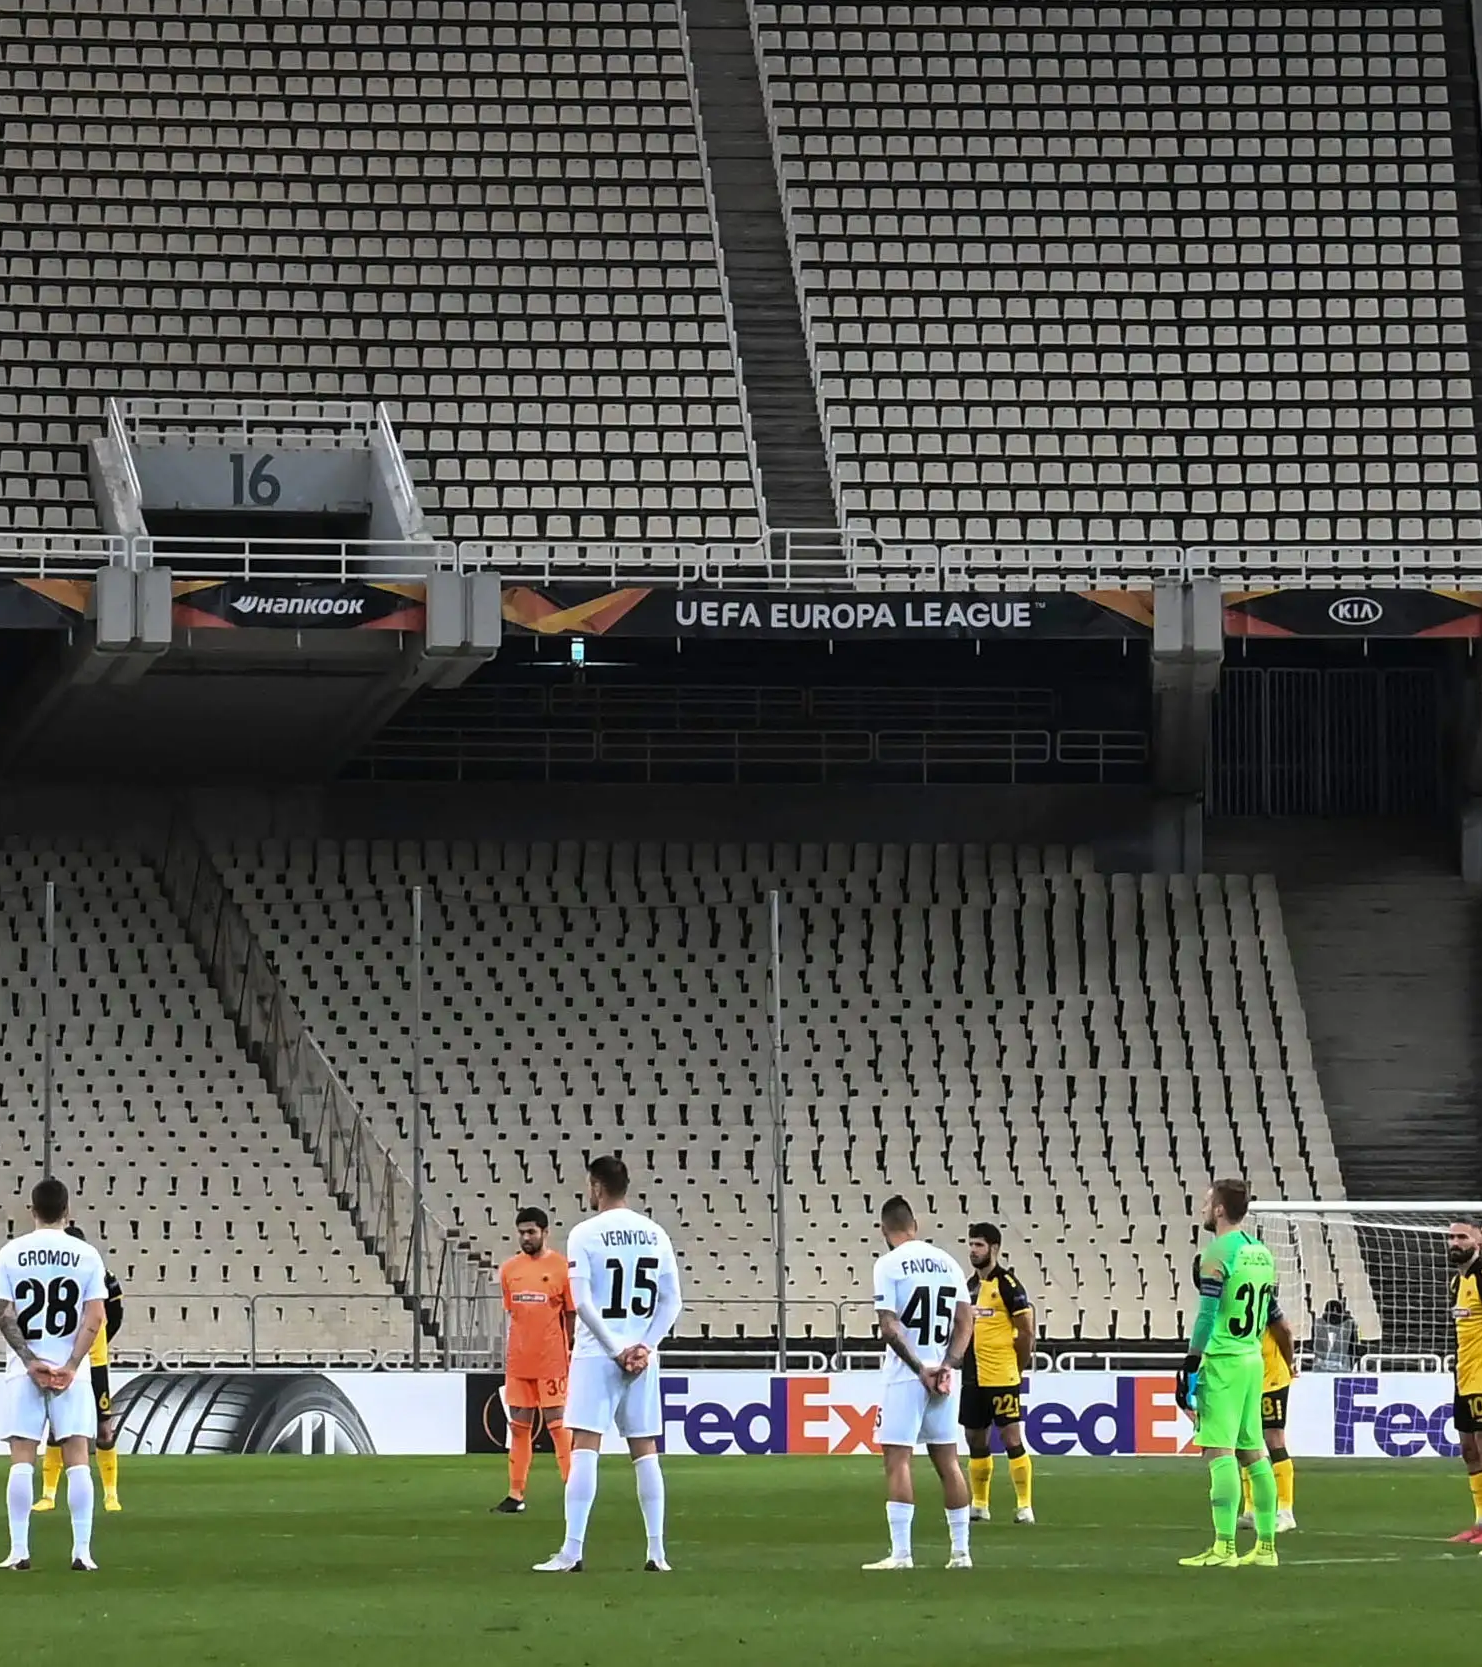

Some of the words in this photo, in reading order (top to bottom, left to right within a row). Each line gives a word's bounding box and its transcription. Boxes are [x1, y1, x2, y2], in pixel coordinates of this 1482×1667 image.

[229, 453, 281, 506] 16
[675, 600, 762, 627] UEFA
[770, 602, 897, 629] EUROPA
[905, 601, 1032, 627] LEAGUE
[1338, 603, 1374, 619] KIA
[18, 1249, 81, 1267] GROMOV
[15, 1275, 80, 1340] 28
[601, 1256, 659, 1320] 15
[900, 1285, 958, 1347] 45
